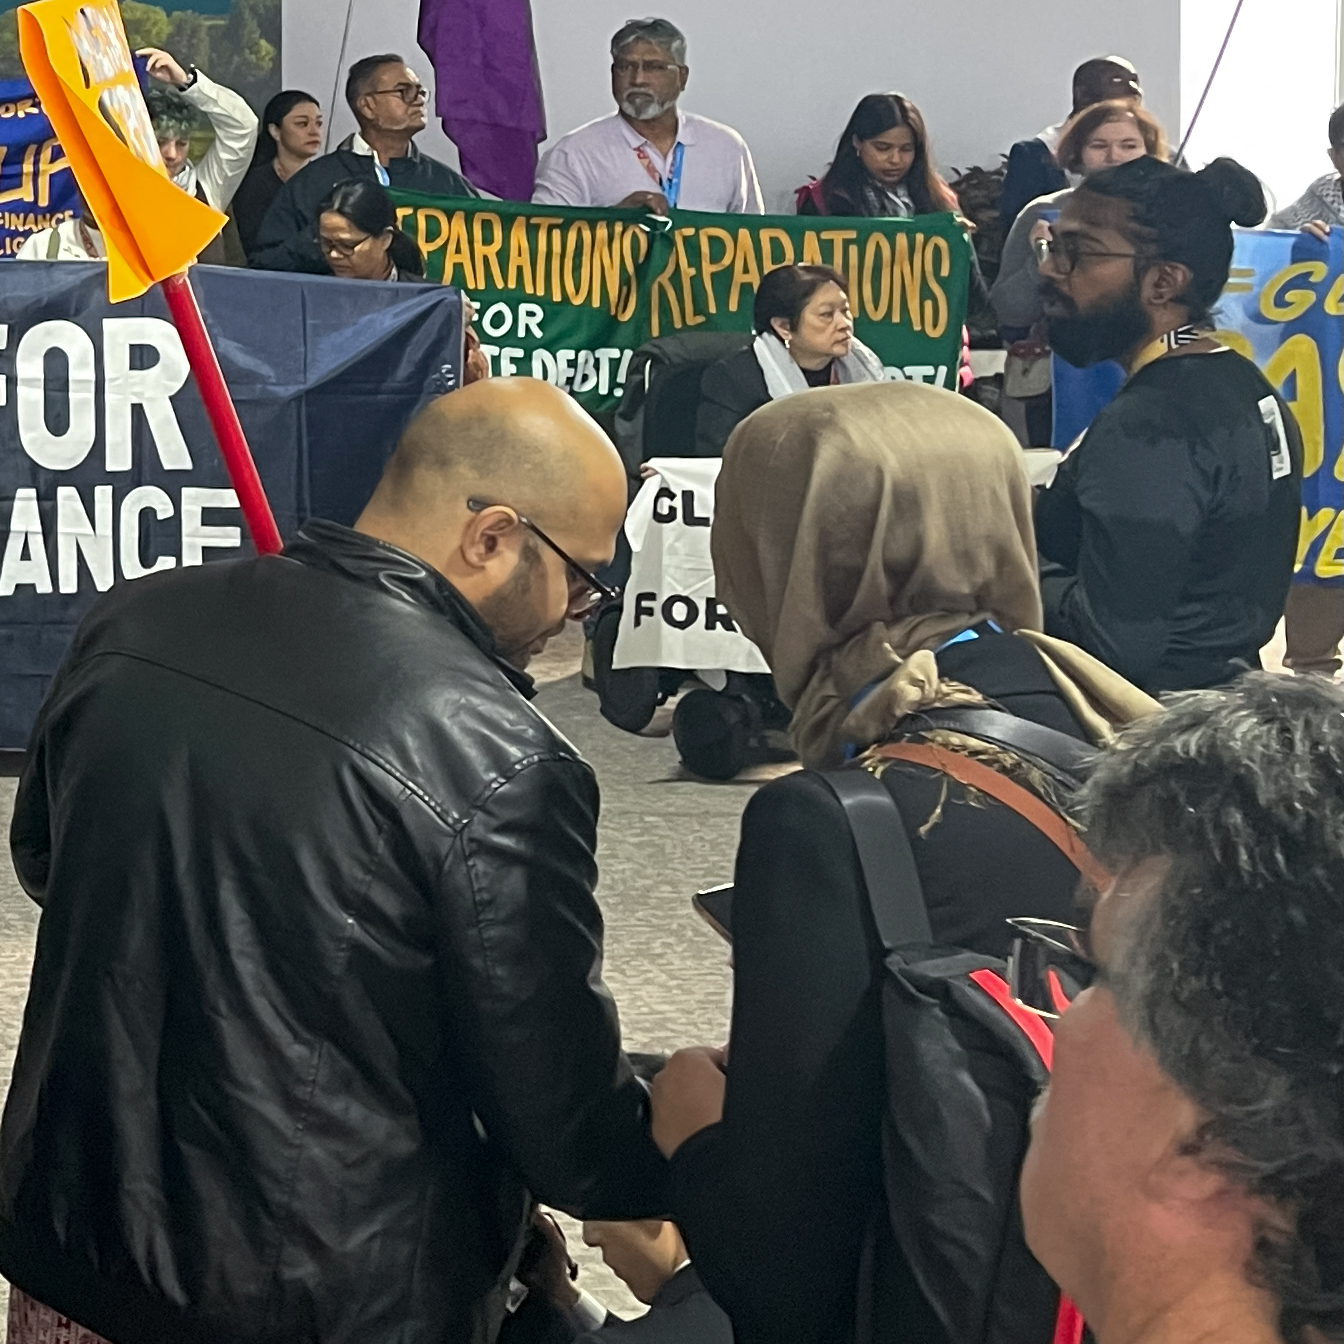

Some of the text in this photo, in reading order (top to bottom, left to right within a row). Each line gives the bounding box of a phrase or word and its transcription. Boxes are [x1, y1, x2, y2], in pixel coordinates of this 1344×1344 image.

[396, 207, 648, 322] PARATIONS
[532, 348, 633, 396] DEBT!
[634, 591, 739, 633] FOR
